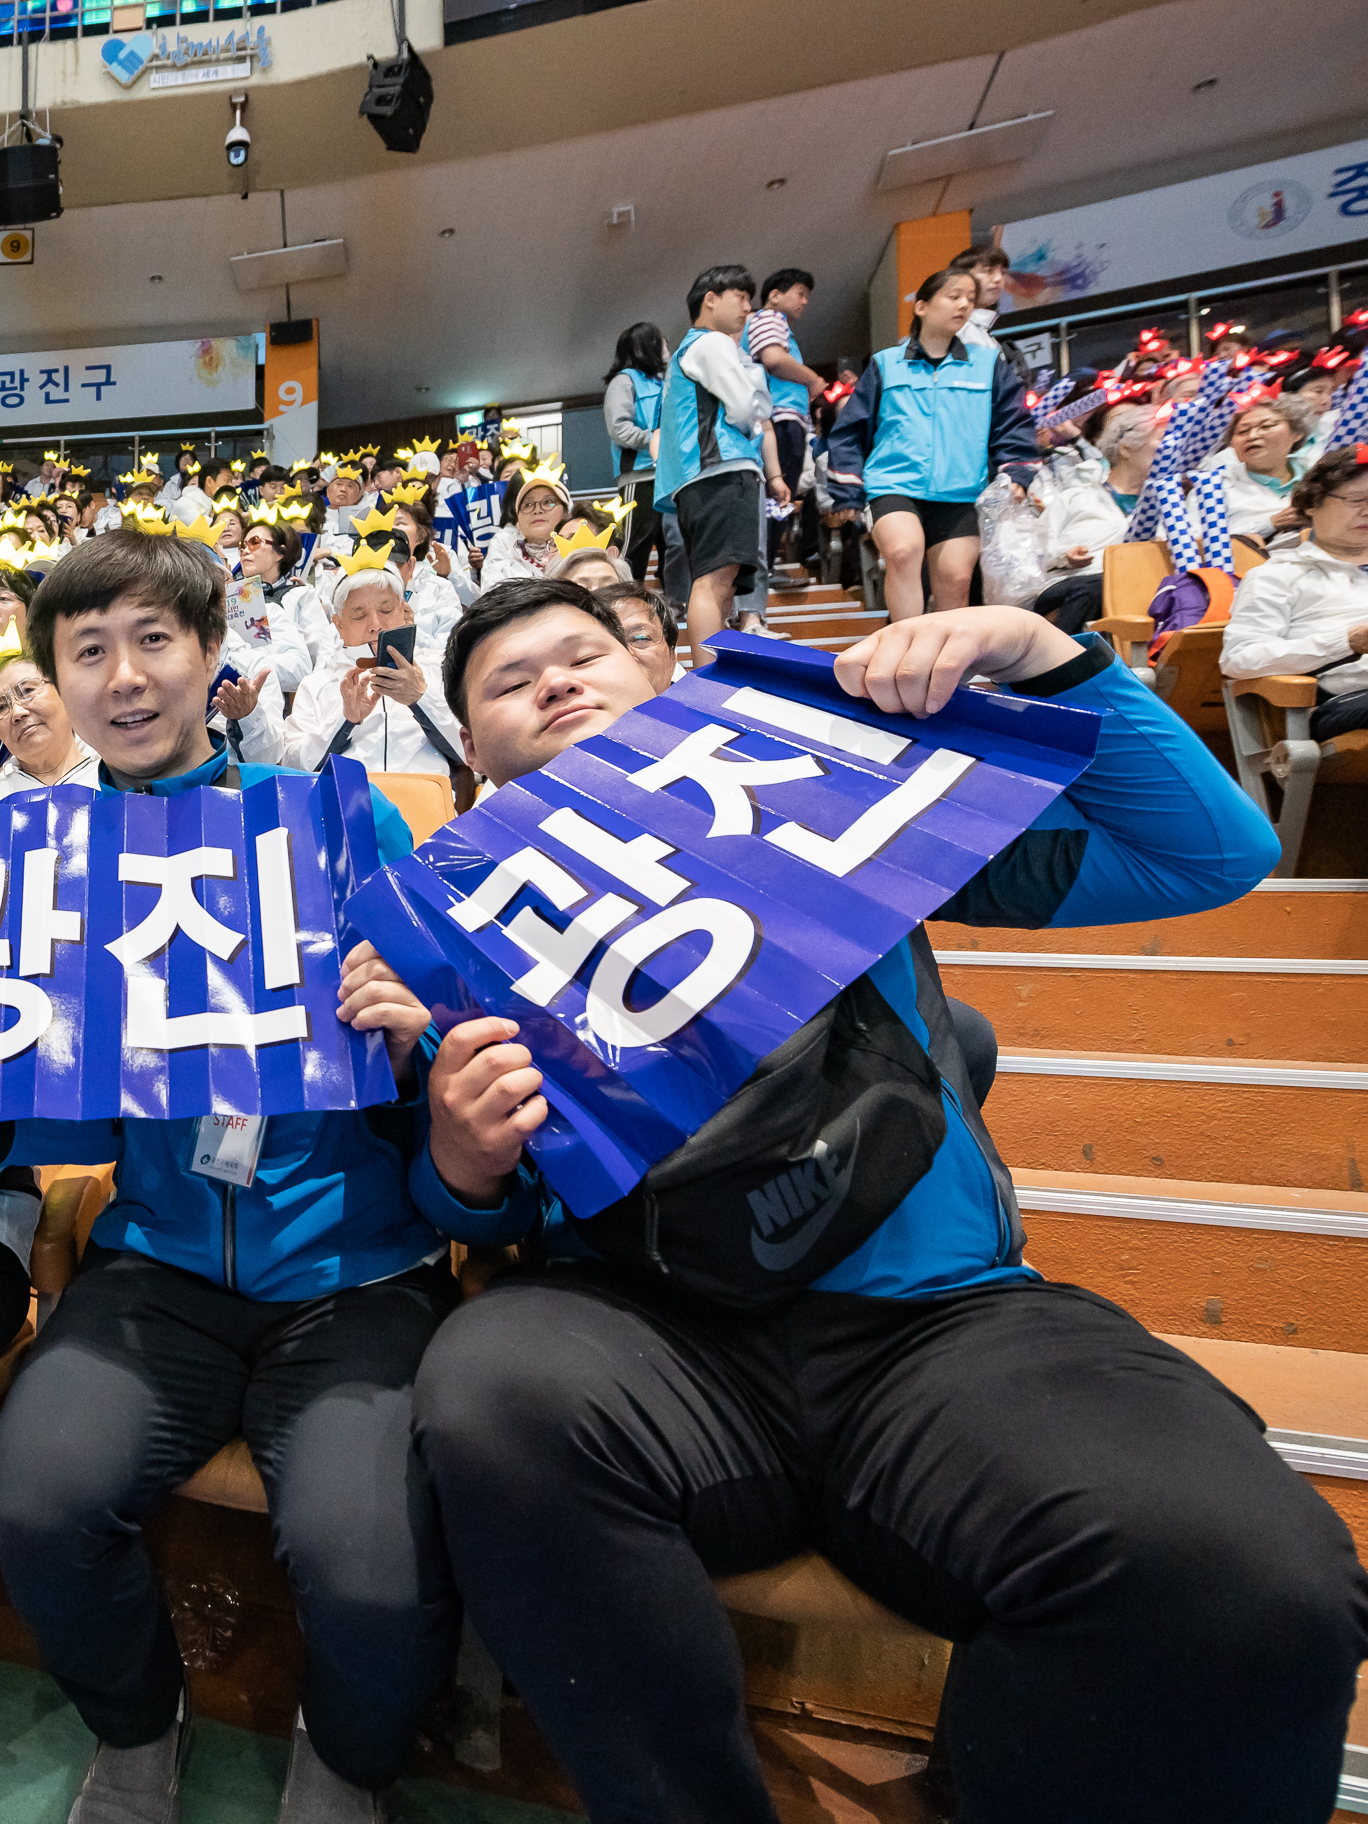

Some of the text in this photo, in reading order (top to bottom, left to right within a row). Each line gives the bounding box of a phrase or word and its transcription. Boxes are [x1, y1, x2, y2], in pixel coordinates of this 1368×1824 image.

[10, 239, 21, 253] 9
[278, 380, 303, 413] 9
[446, 686, 977, 1048] 광진
[213, 1115, 249, 1131] STAFF
[746, 1147, 844, 1238] NIKE
